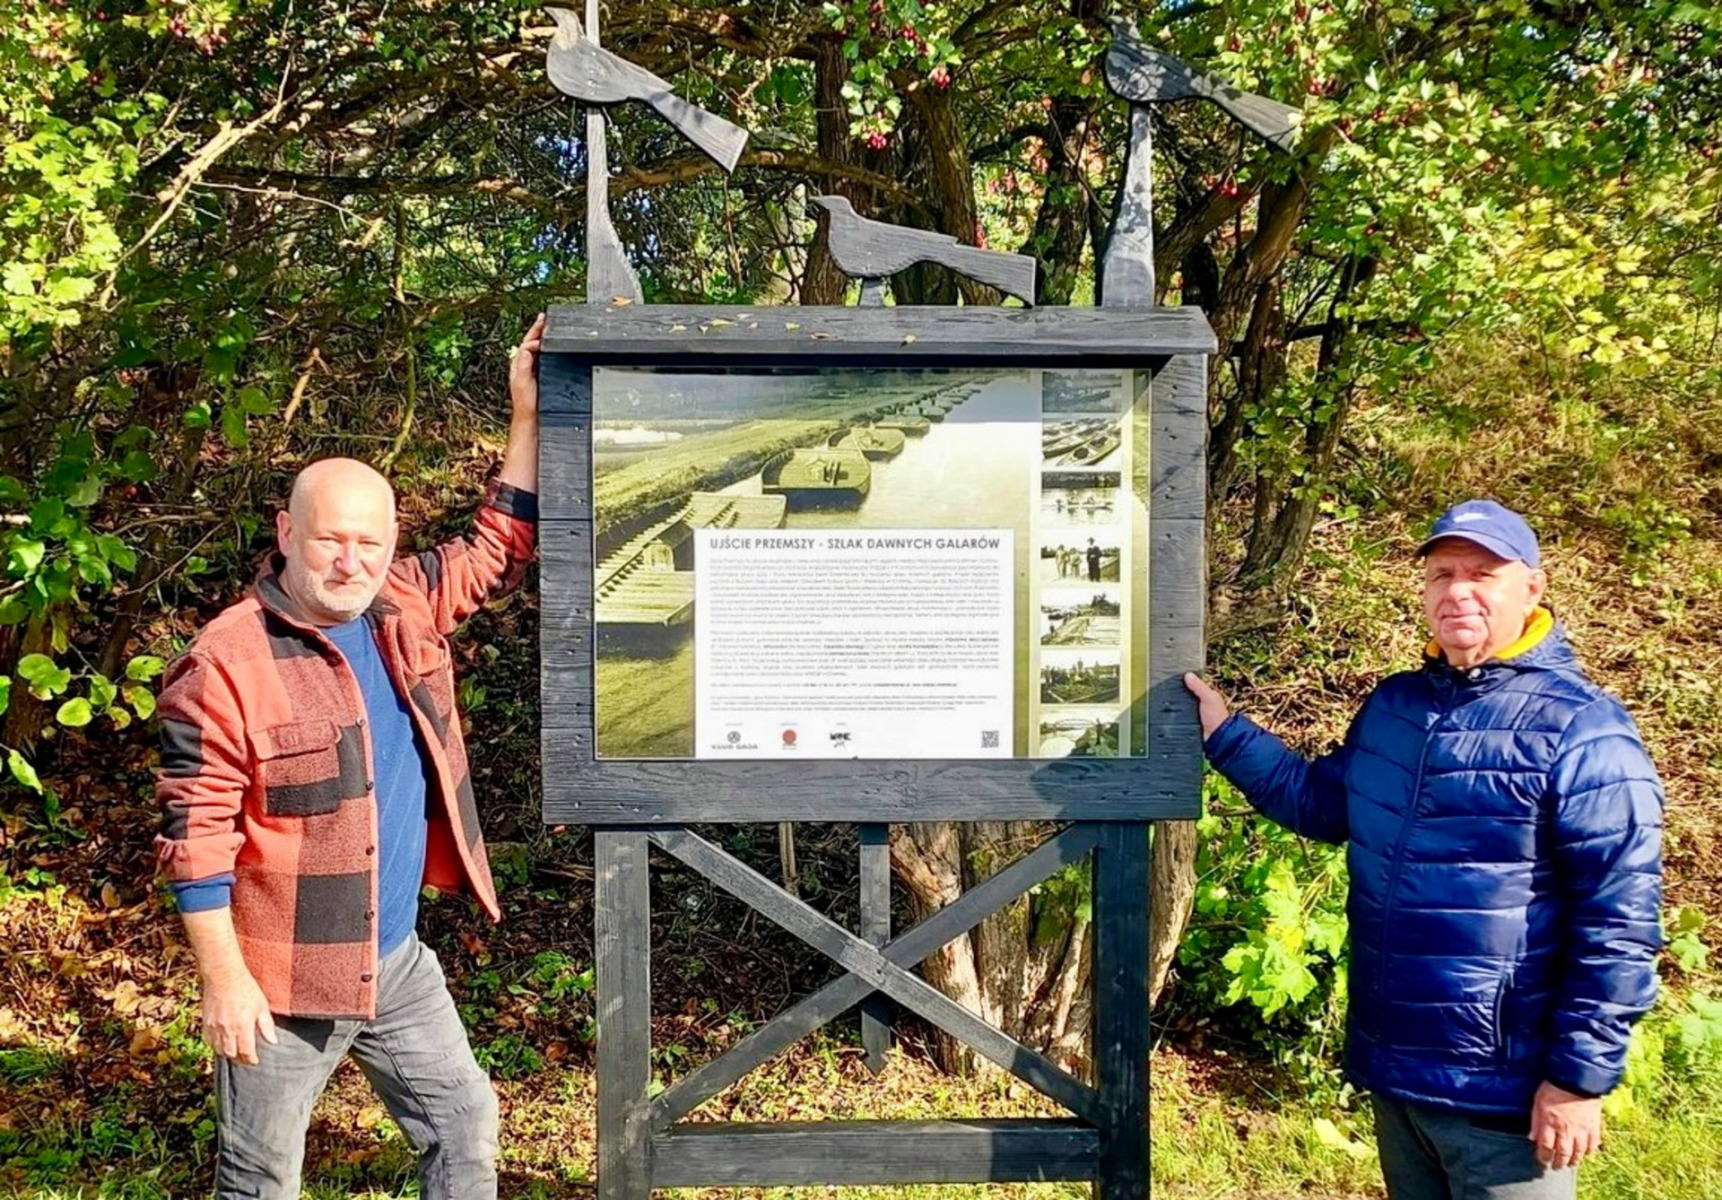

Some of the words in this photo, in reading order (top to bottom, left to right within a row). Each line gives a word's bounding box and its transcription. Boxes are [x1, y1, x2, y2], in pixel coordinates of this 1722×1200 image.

[710, 535, 751, 549] UJŚCIE
[755, 538, 815, 549] PRZEMSZY
[827, 538, 862, 549] SZLAK
[867, 538, 932, 549] DAWNYCH
[936, 534, 1000, 549] GALARÓW
